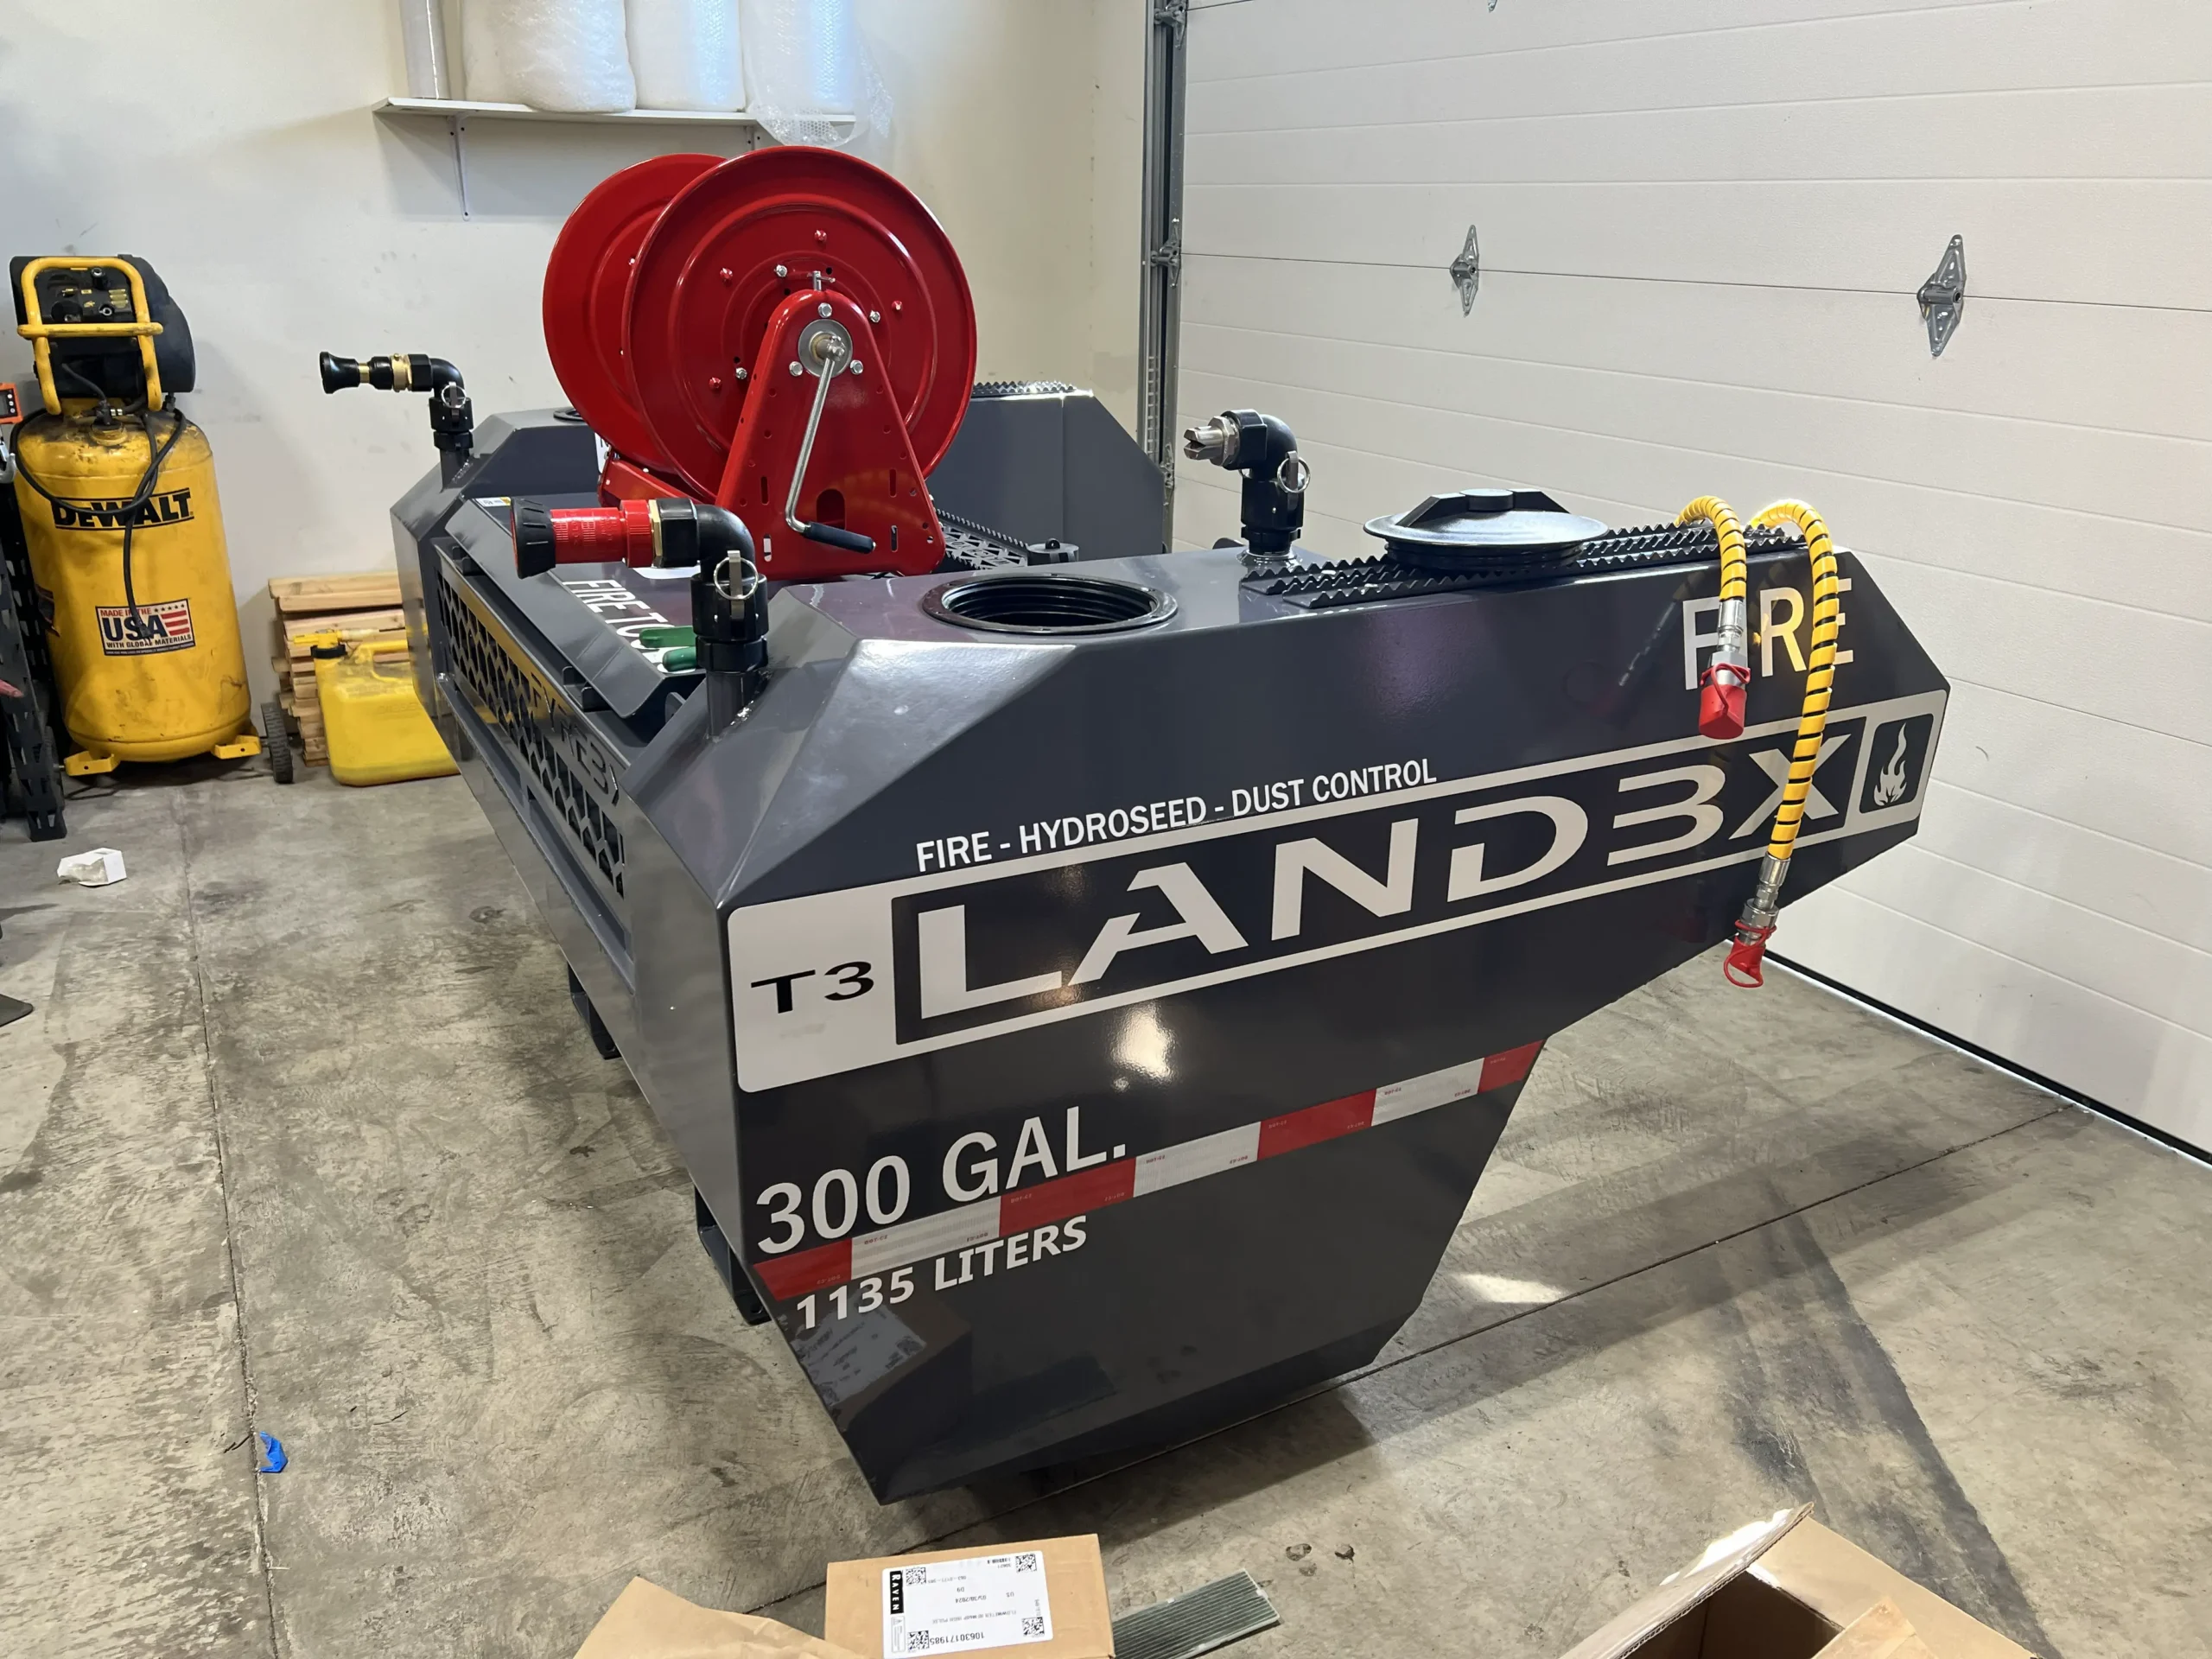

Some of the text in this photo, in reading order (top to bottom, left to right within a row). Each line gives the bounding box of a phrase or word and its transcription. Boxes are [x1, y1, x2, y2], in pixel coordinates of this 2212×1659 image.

[52, 492, 191, 526] DEWALT
[563, 580, 651, 613] FIRE
[102, 614, 168, 641] USA
[155, 634, 191, 645] MATERIALS
[1683, 578, 1854, 690] FR
[916, 831, 992, 872] FIRE
[1019, 796, 1206, 854] HYDROSEED
[1231, 779, 1304, 817] DUST
[1313, 758, 1437, 803] CONTROL
[751, 961, 875, 1014] T3
[756, 1106, 1126, 1255] 300 GAL.
[797, 1215, 1087, 1330] 1135 LITERS
[892, 1573, 901, 1611] RAVEN
[930, 1631, 986, 1645] 10630171985
